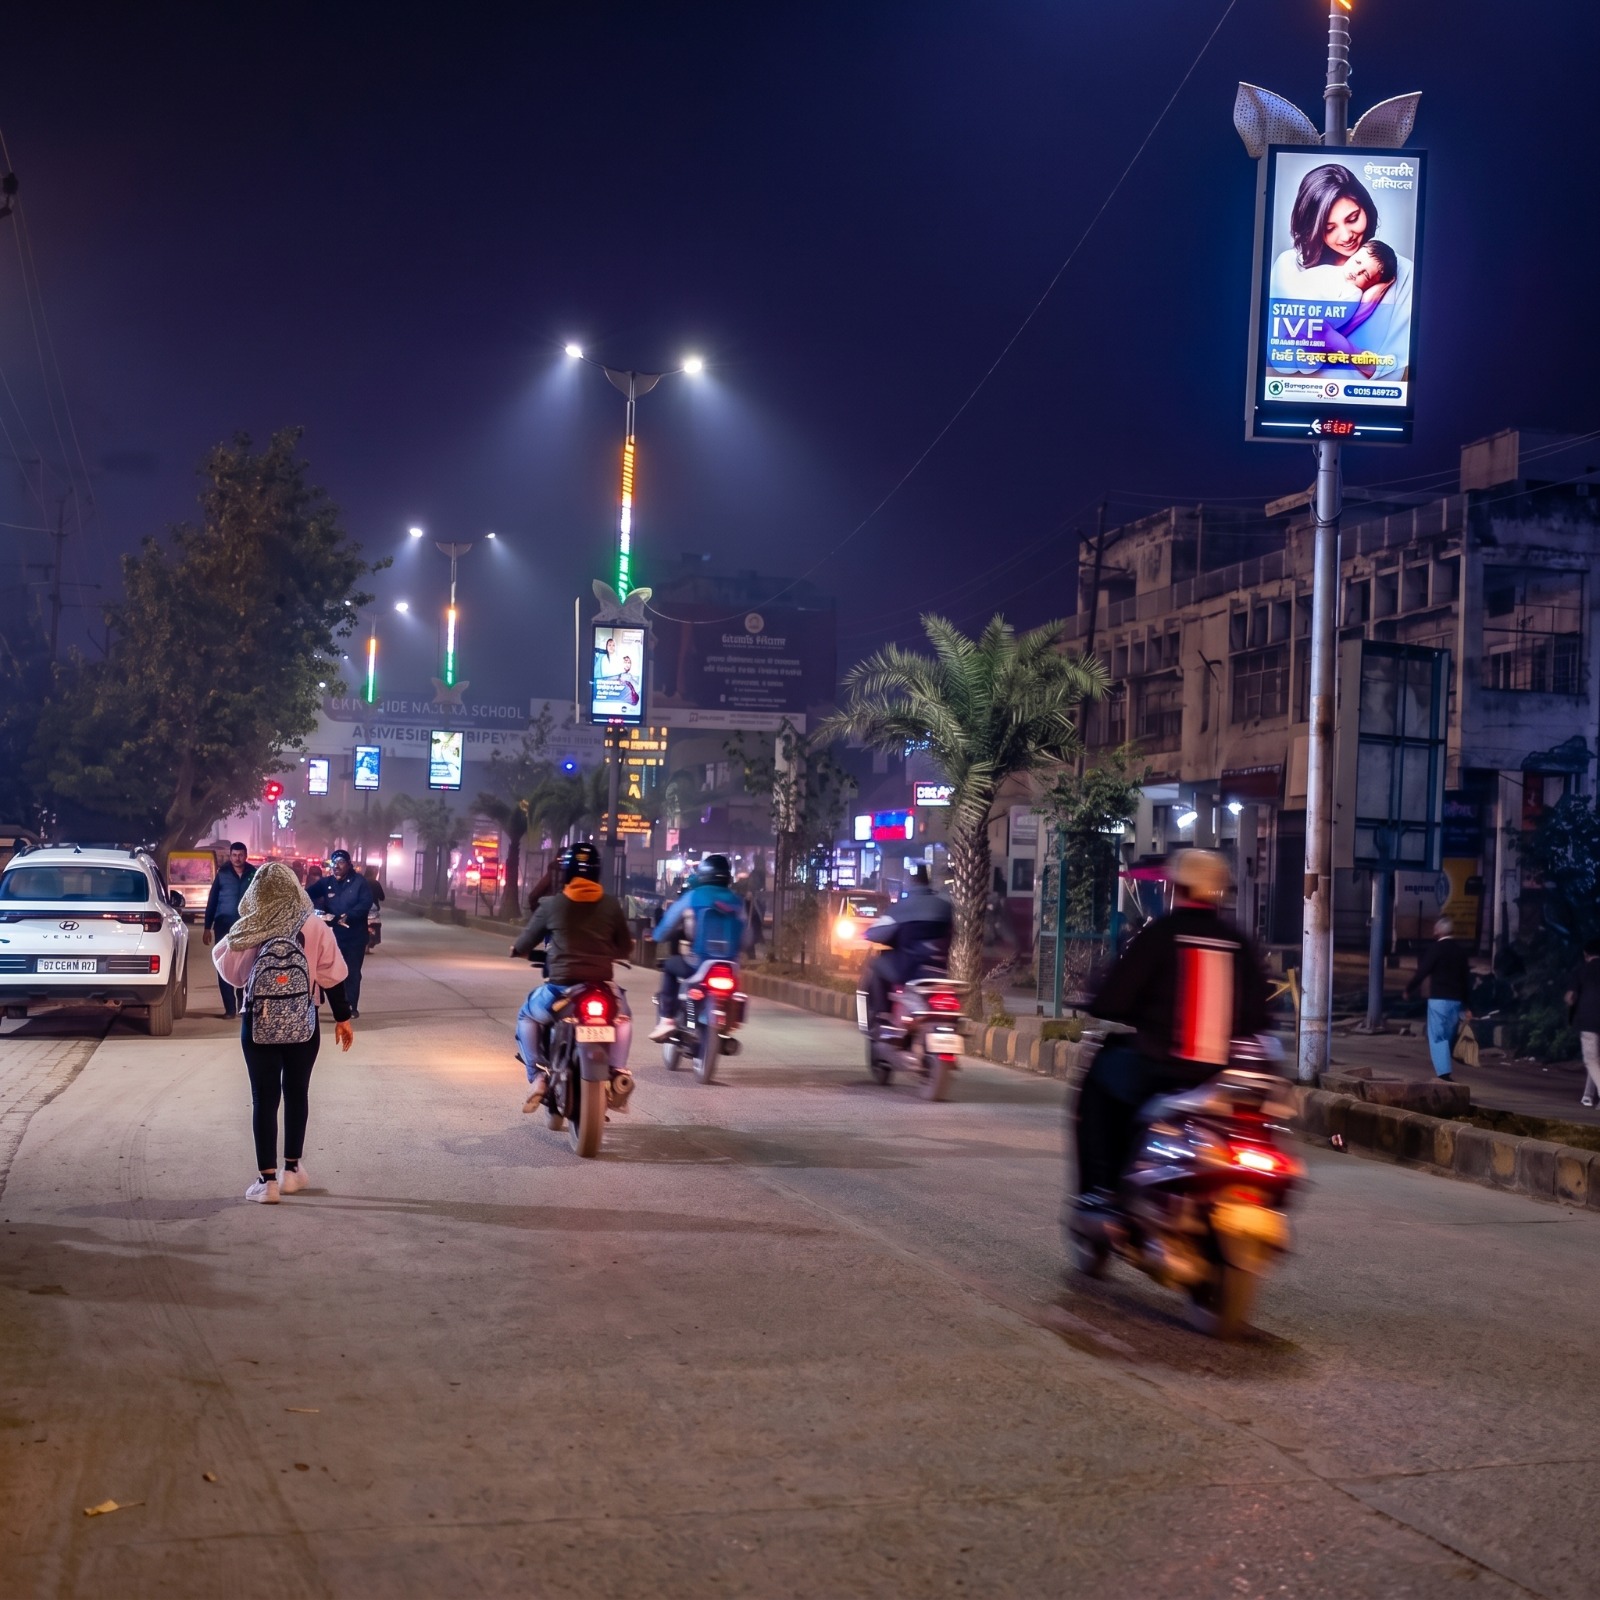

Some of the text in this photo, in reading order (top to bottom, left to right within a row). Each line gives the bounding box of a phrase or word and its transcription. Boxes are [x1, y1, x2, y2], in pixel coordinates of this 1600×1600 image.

[1272, 303, 1347, 318] STATE OF ART
[1273, 317, 1324, 339] IVF
[472, 703, 525, 719] SCHOOL
